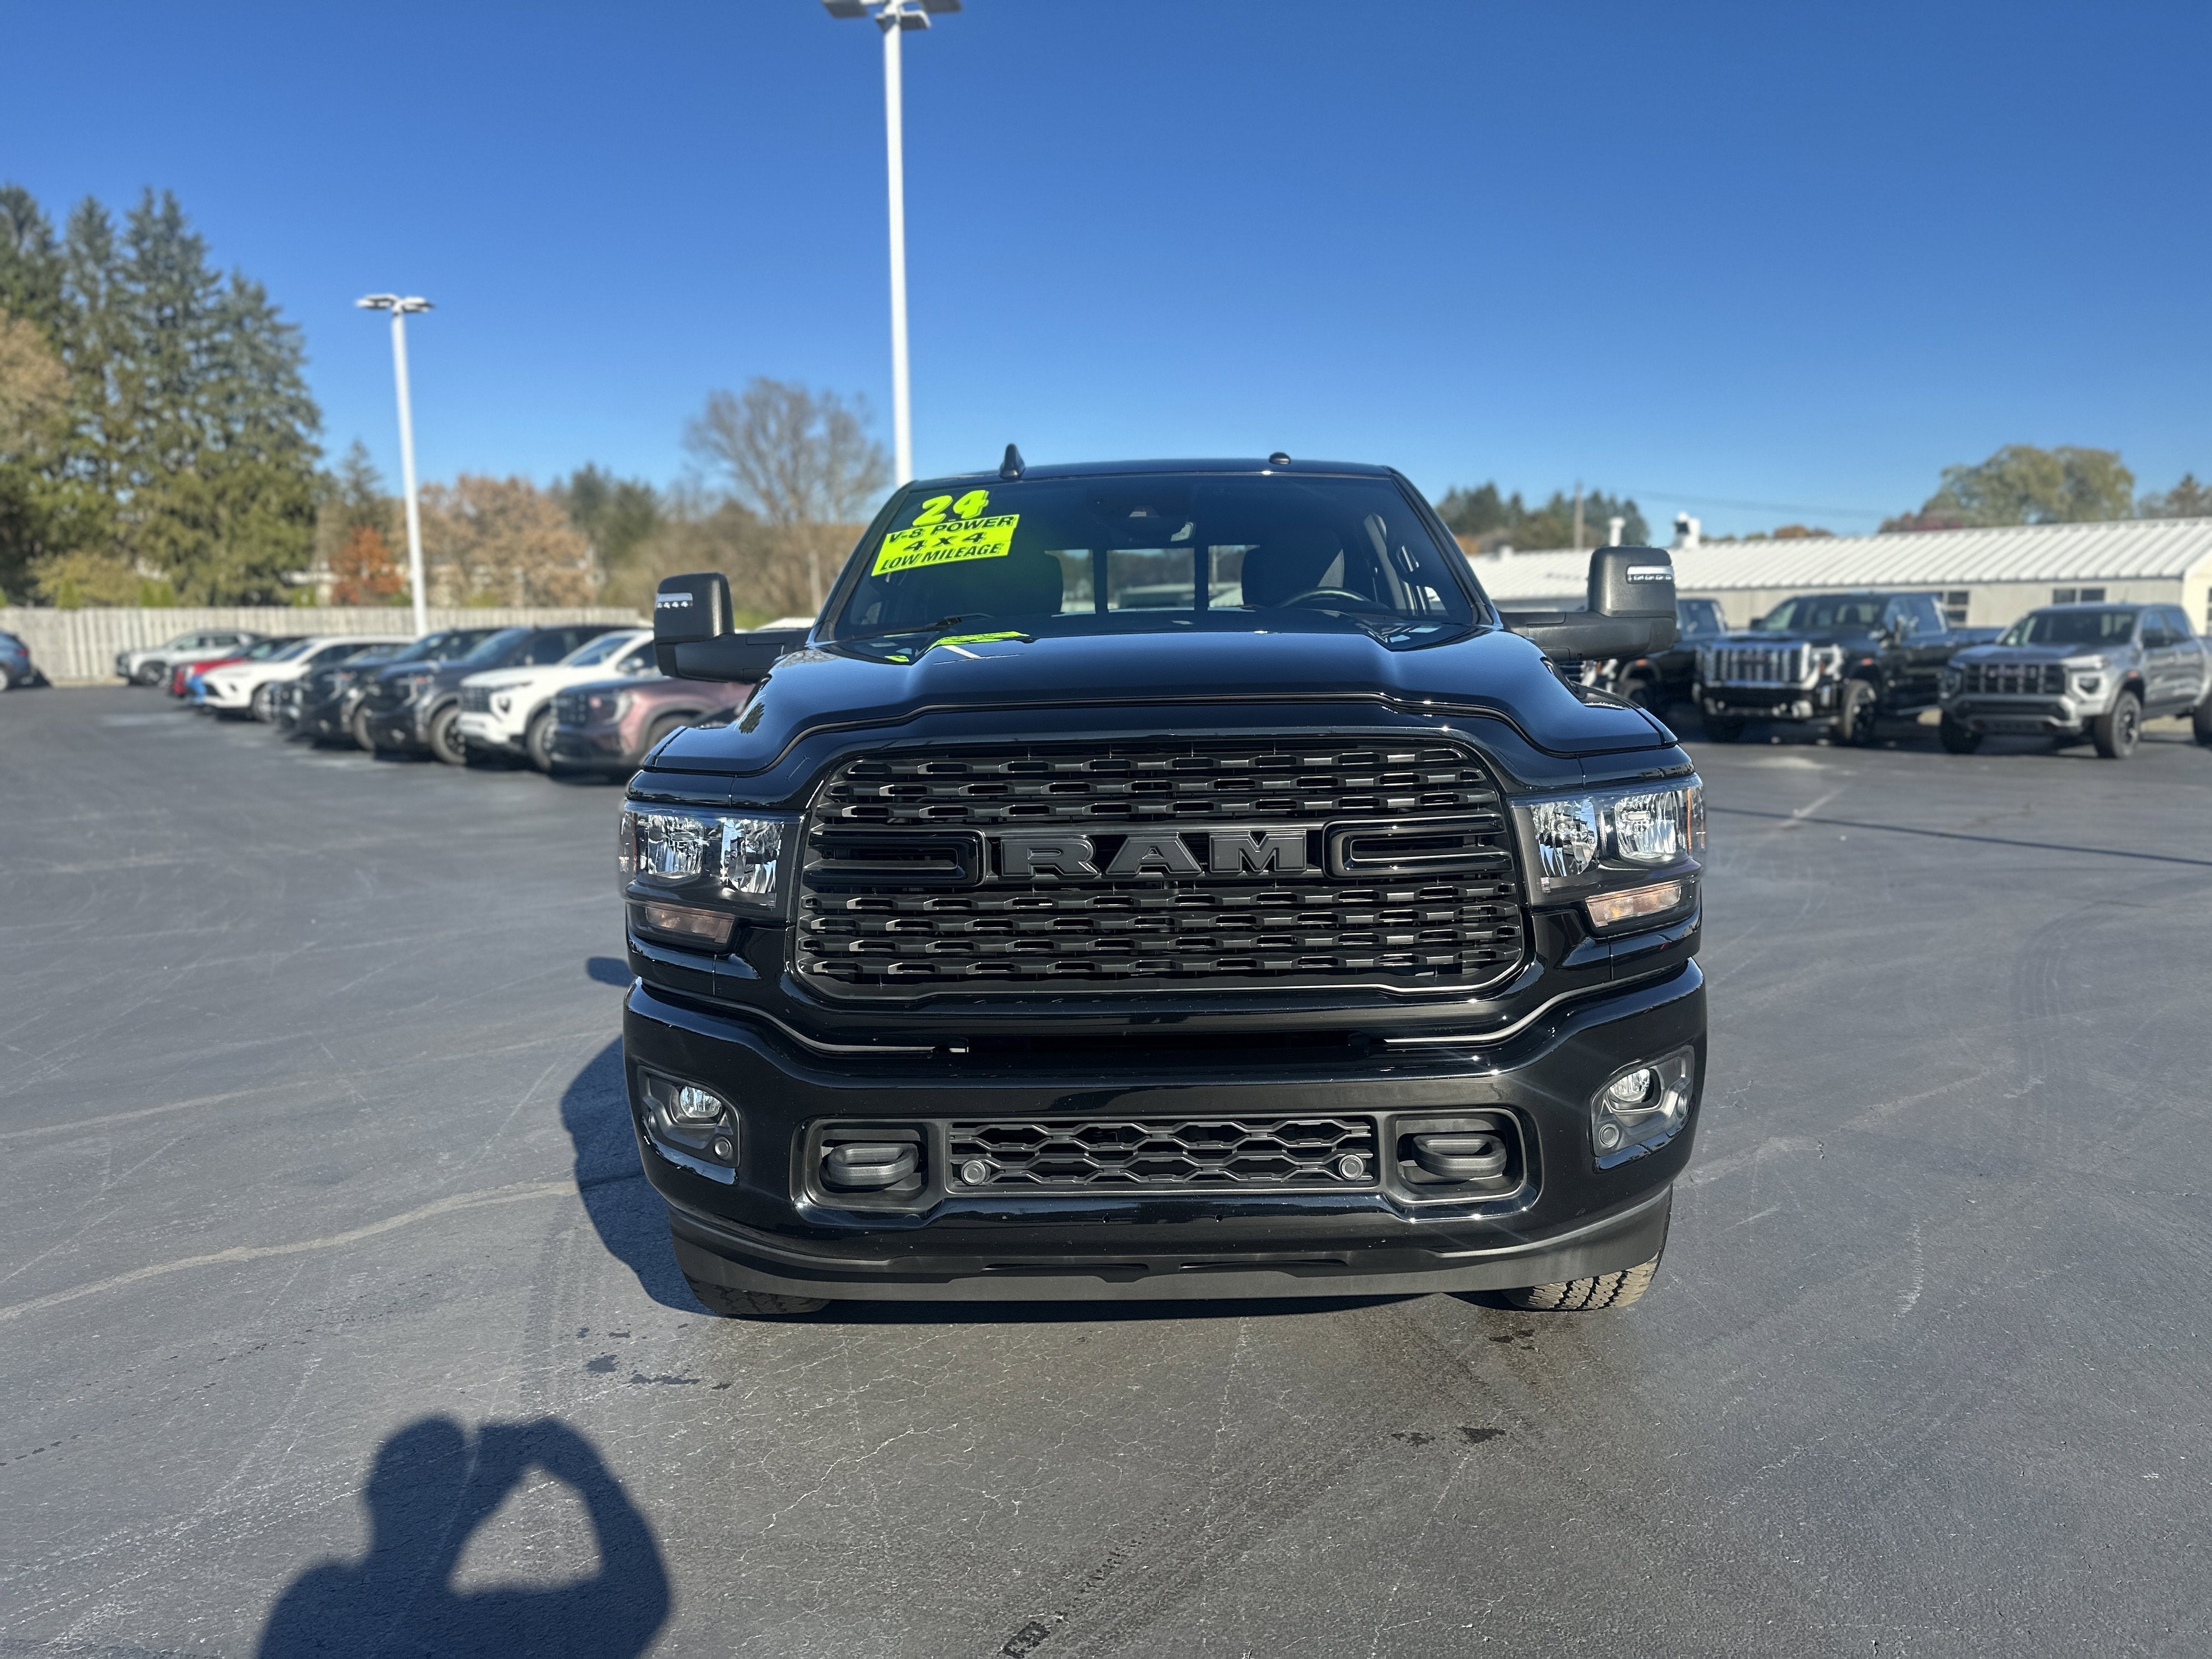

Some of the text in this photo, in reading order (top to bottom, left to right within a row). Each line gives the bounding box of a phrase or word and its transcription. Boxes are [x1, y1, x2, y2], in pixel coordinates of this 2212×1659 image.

[912, 490, 989, 526] 24
[889, 516, 1015, 543] V-8 POWER
[904, 539, 927, 552] 4
[962, 532, 986, 543] 4
[880, 543, 1002, 571] LOW MILEAGE
[1001, 830, 1308, 877] RAM
